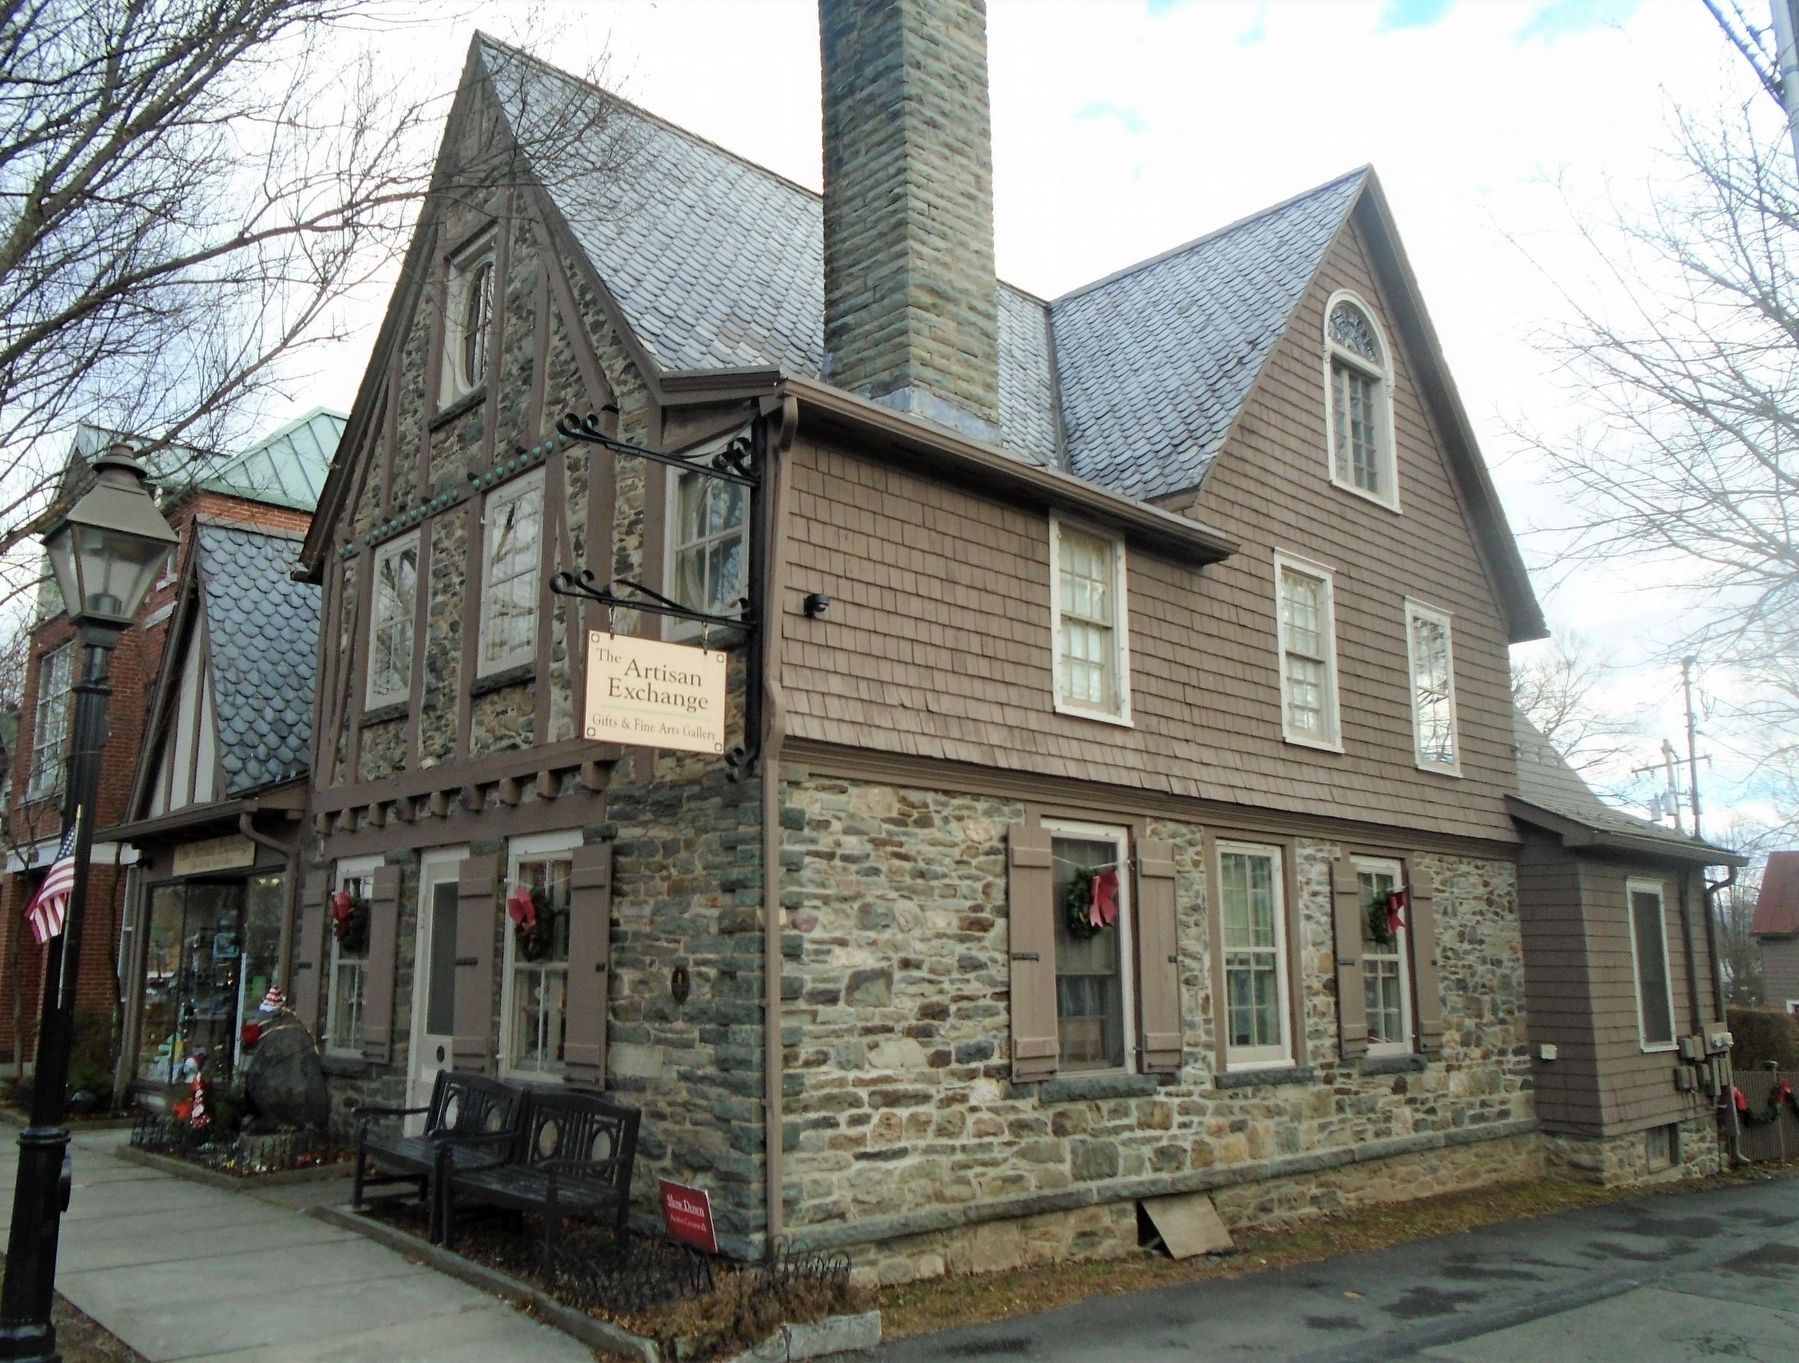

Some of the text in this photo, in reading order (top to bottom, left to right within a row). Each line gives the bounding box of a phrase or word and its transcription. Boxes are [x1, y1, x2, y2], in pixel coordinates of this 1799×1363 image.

[596, 647, 702, 687] The Artisan
[608, 676, 709, 713] Exchange
[592, 713, 717, 742] Gifts & Fine Arts Gallery
